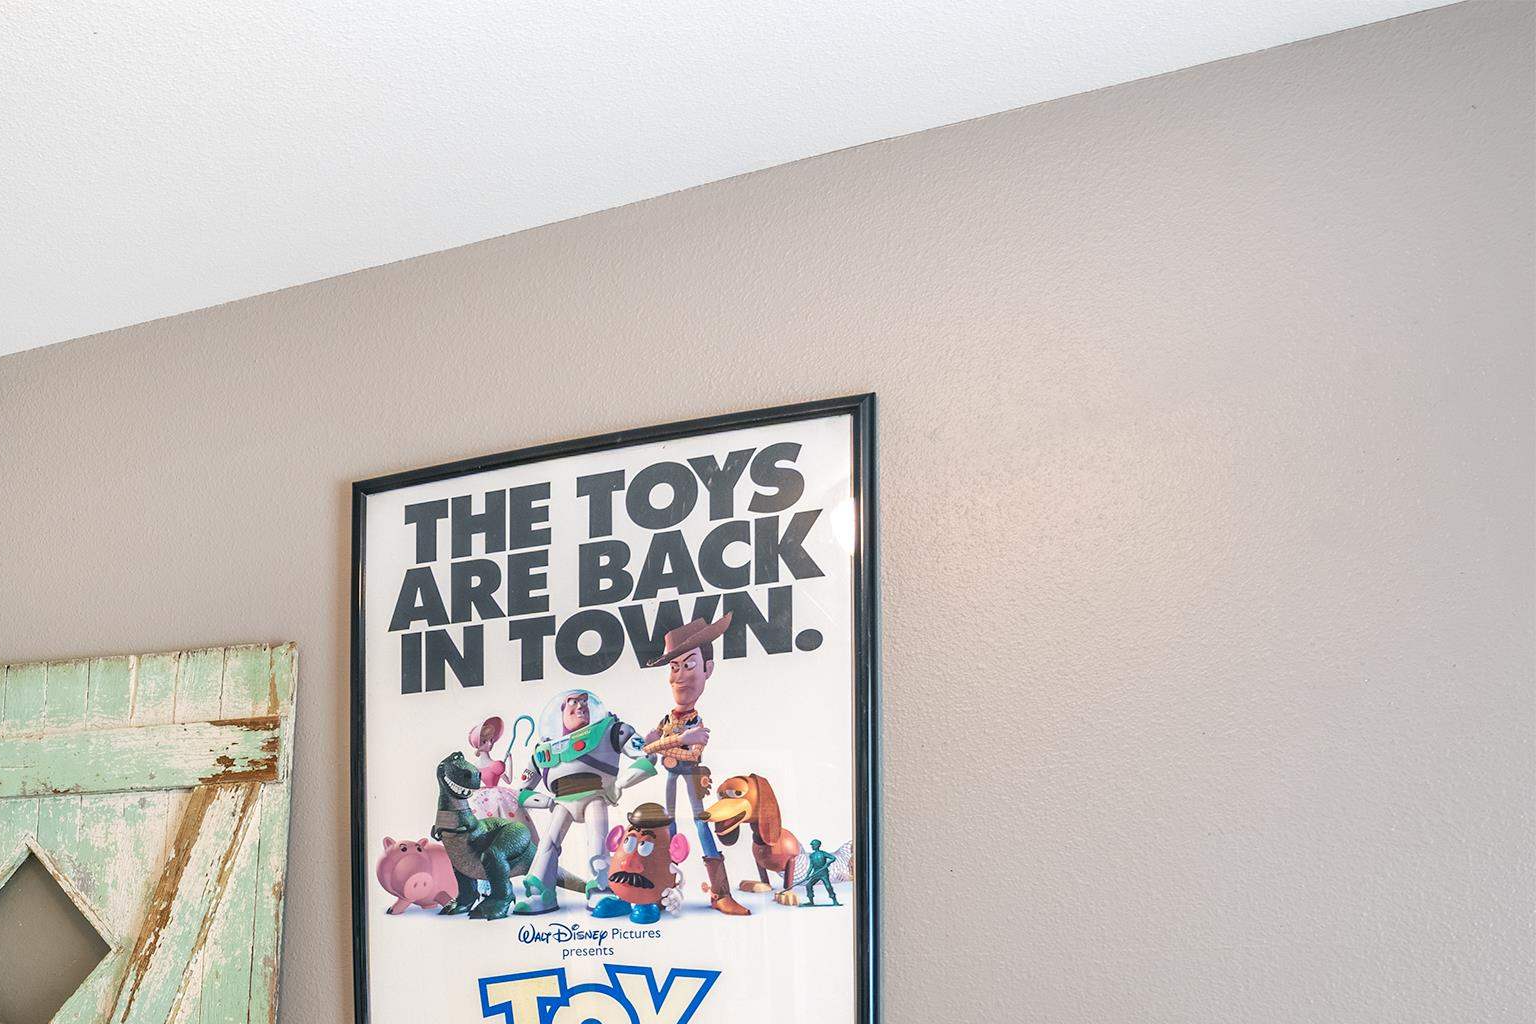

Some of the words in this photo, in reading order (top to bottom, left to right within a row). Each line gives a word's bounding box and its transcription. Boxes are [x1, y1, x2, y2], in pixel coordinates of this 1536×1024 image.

[404, 481, 551, 564] THE
[576, 442, 805, 538] TOYS
[388, 550, 550, 632] ARE
[578, 508, 825, 608] BACK
[401, 624, 485, 695] IN
[509, 585, 824, 682] TOWN.
[562, 946, 614, 960] presents
[611, 928, 661, 940] Pictures
